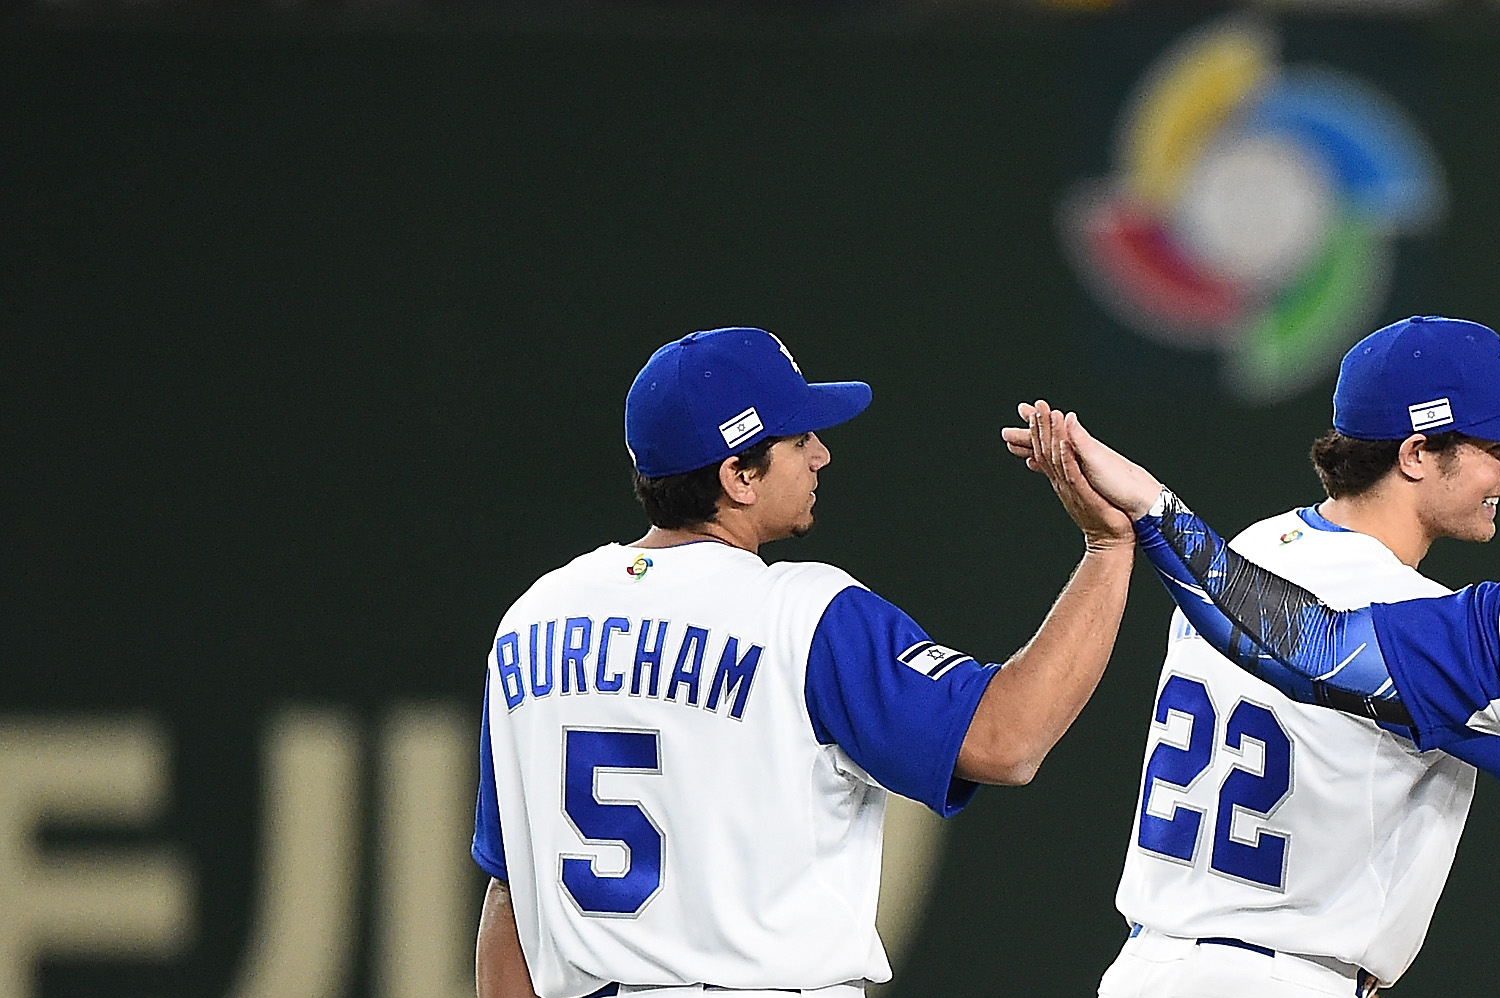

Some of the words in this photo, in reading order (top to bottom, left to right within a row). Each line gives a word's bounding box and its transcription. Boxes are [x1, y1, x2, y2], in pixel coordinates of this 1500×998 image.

[496, 615, 766, 722] BURCHAM
[558, 725, 666, 920] 5
[1138, 670, 1296, 893] 22
